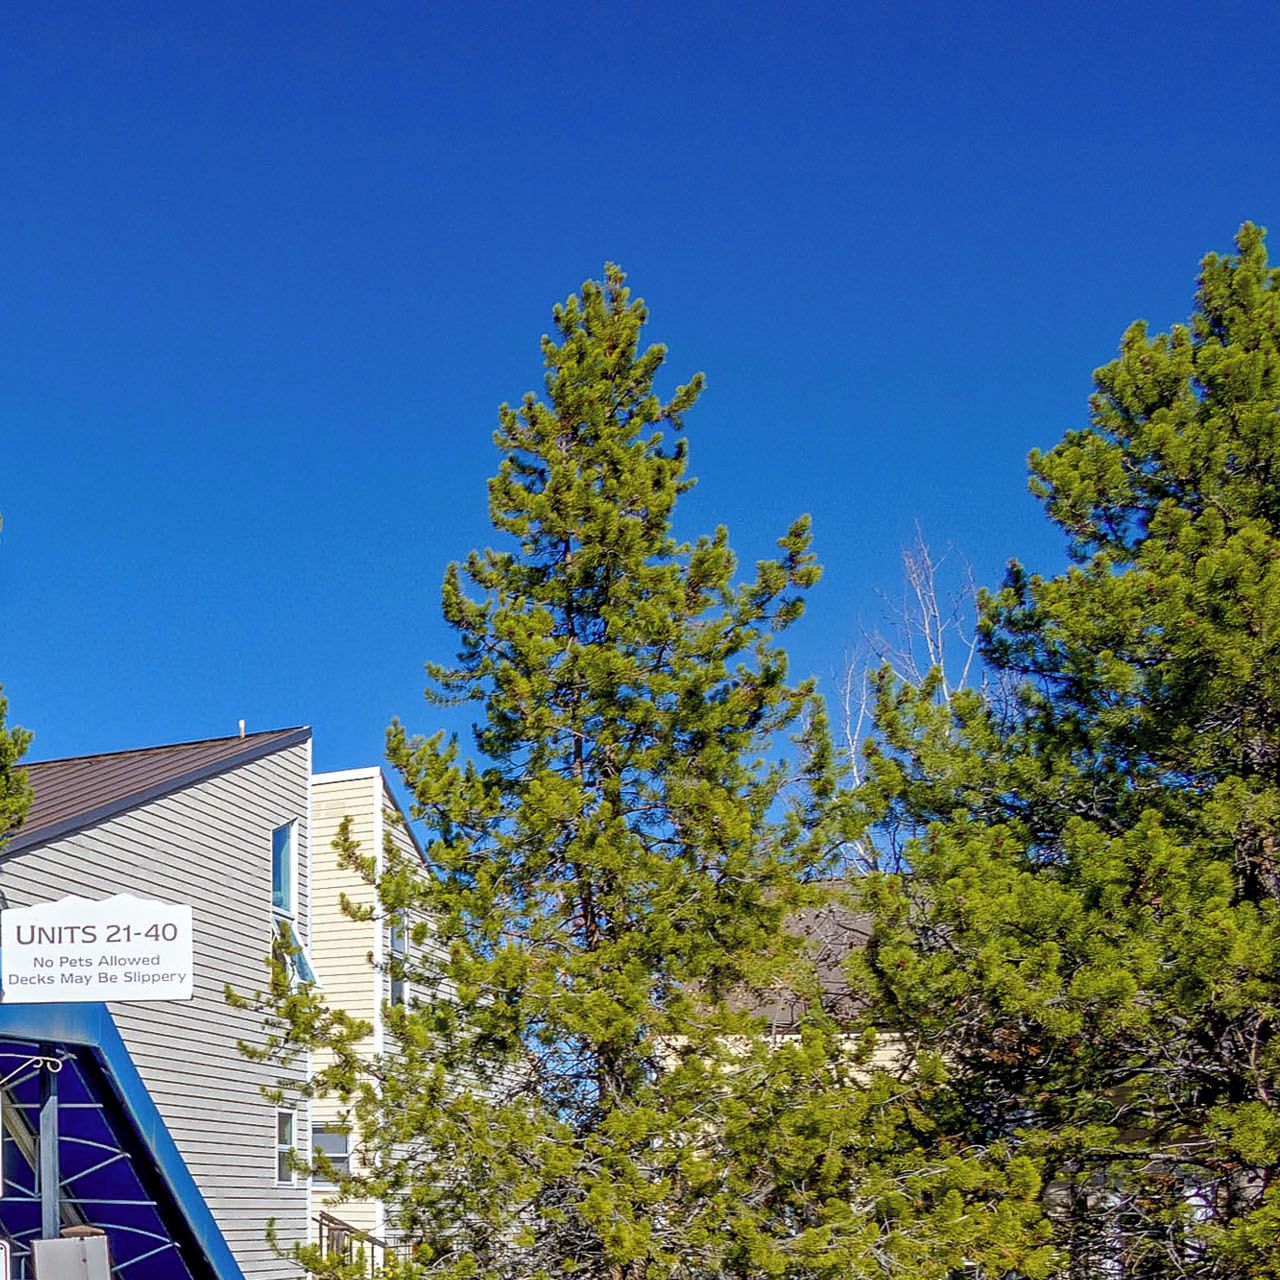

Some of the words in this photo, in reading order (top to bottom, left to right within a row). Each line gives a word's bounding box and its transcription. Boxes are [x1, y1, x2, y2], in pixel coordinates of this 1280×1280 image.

[16, 925, 97, 945] UNITS
[106, 923, 178, 943] 21-40
[33, 957, 54, 968] No
[59, 956, 93, 968] Pets
[98, 955, 161, 967] Allowed
[8, 973, 55, 985] Decks
[60, 973, 92, 986] May
[98, 972, 118, 983] Be
[124, 971, 187, 984] Slippery
